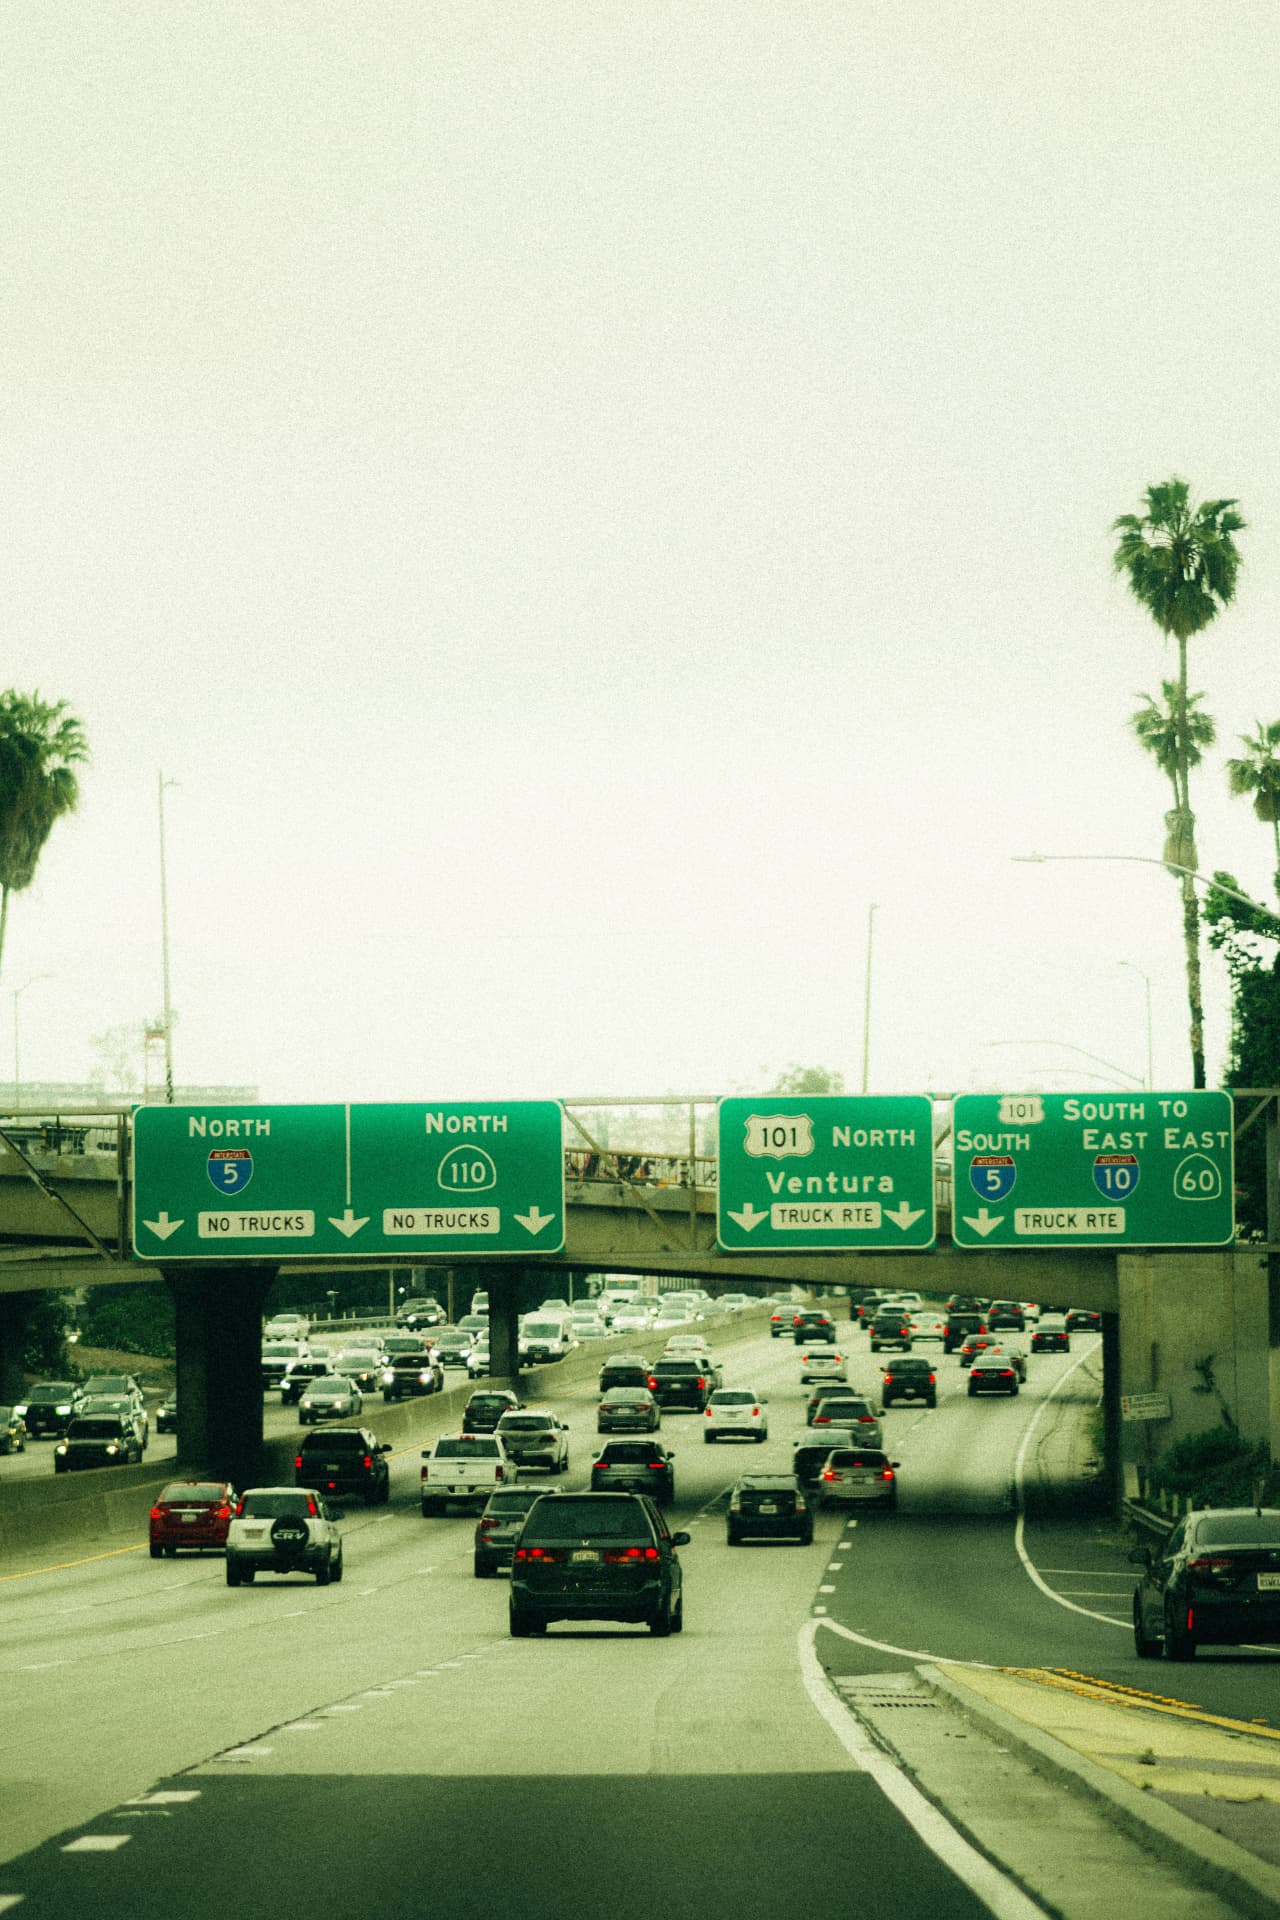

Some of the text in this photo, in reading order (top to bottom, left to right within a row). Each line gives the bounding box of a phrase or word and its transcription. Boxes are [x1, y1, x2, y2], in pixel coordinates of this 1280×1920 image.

[1009, 1099, 1188, 1120] 101 SOUTH TO
[188, 1116, 271, 1138] NORTH
[425, 1112, 508, 1134] NORTH
[762, 1126, 915, 1147] 101 NORTH
[956, 1130, 1030, 1151] SOUTH
[1083, 1129, 1148, 1150] EAST
[1164, 1128, 1229, 1149] EAST
[224, 1163, 238, 1184] 5
[450, 1162, 486, 1184] 110
[766, 1171, 894, 1194] Ventura
[987, 1169, 1001, 1191] 5
[1104, 1168, 1131, 1190] 10
[1182, 1170, 1214, 1191] 60
[208, 1216, 305, 1232] NO TRUCKS
[392, 1213, 490, 1229] NO TRUCKS
[779, 1208, 873, 1223] TRUCK RTE
[1022, 1213, 1118, 1228] TRUCK RTE
